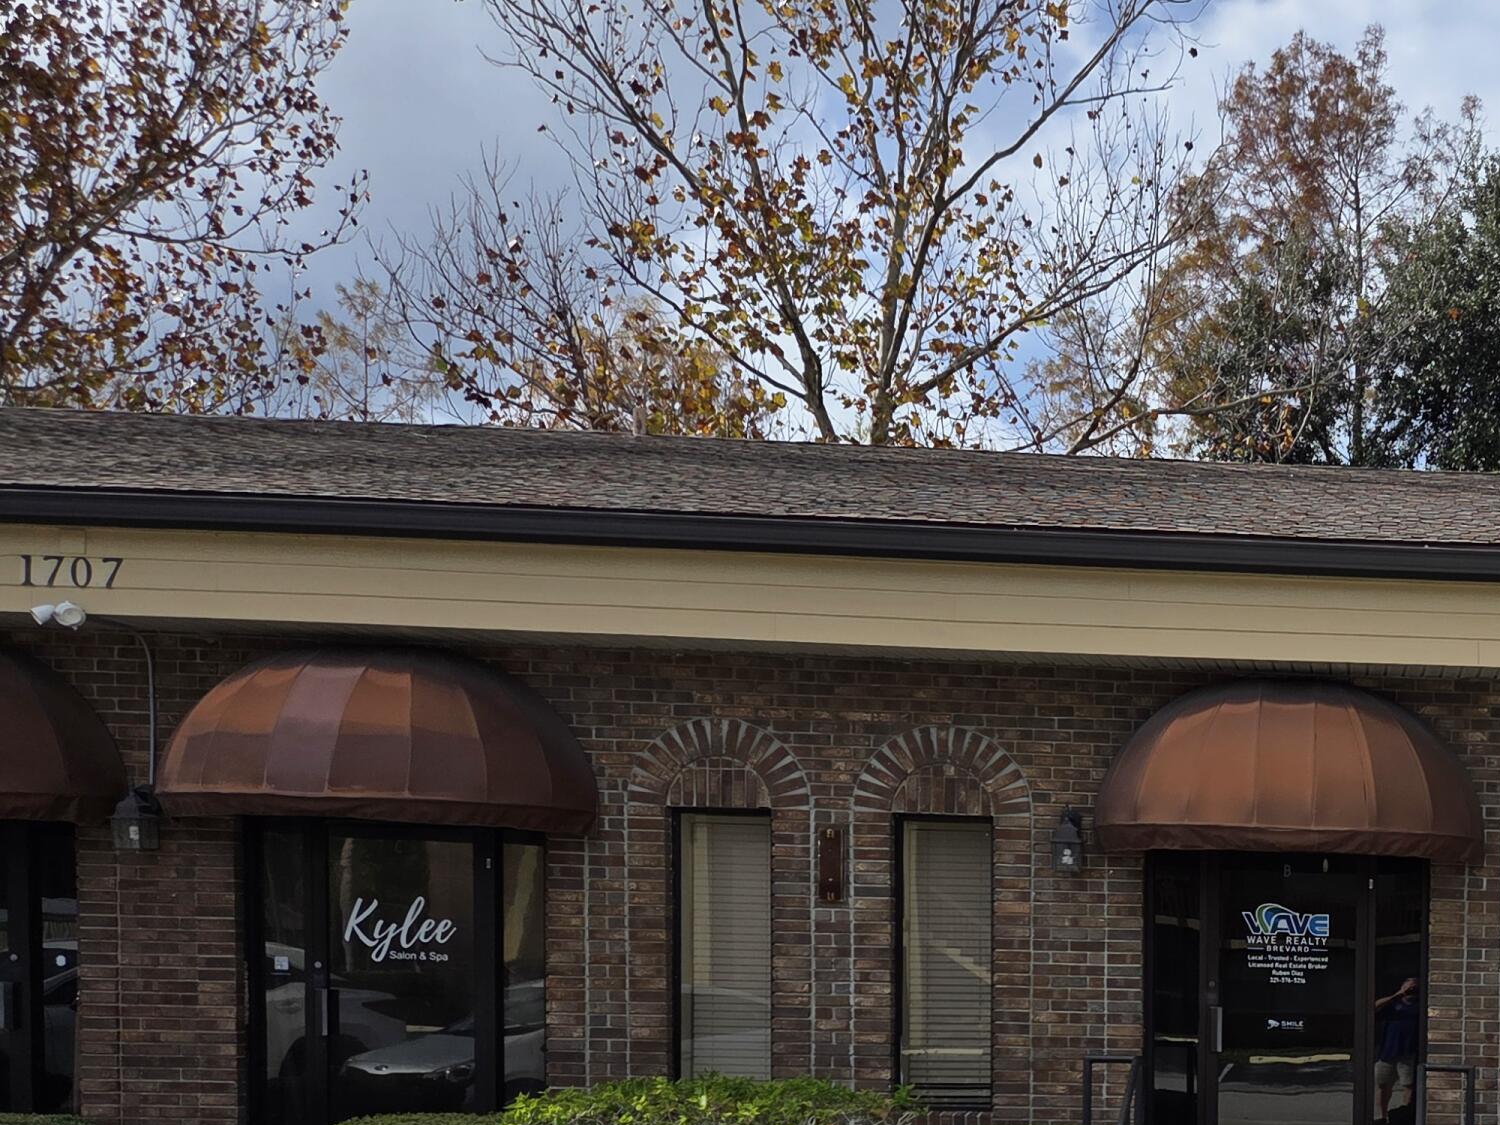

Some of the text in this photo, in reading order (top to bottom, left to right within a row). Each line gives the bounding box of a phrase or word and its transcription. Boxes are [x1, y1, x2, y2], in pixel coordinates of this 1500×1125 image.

[20, 554, 125, 589] 1707
[1283, 864, 1292, 878] B
[1241, 903, 1330, 937] WAVE
[344, 896, 457, 962] Kylee
[1246, 936, 1328, 946] WAVE REALTY
[1266, 945, 1310, 953] BREVARD
[389, 951, 449, 962] Salon & Spa
